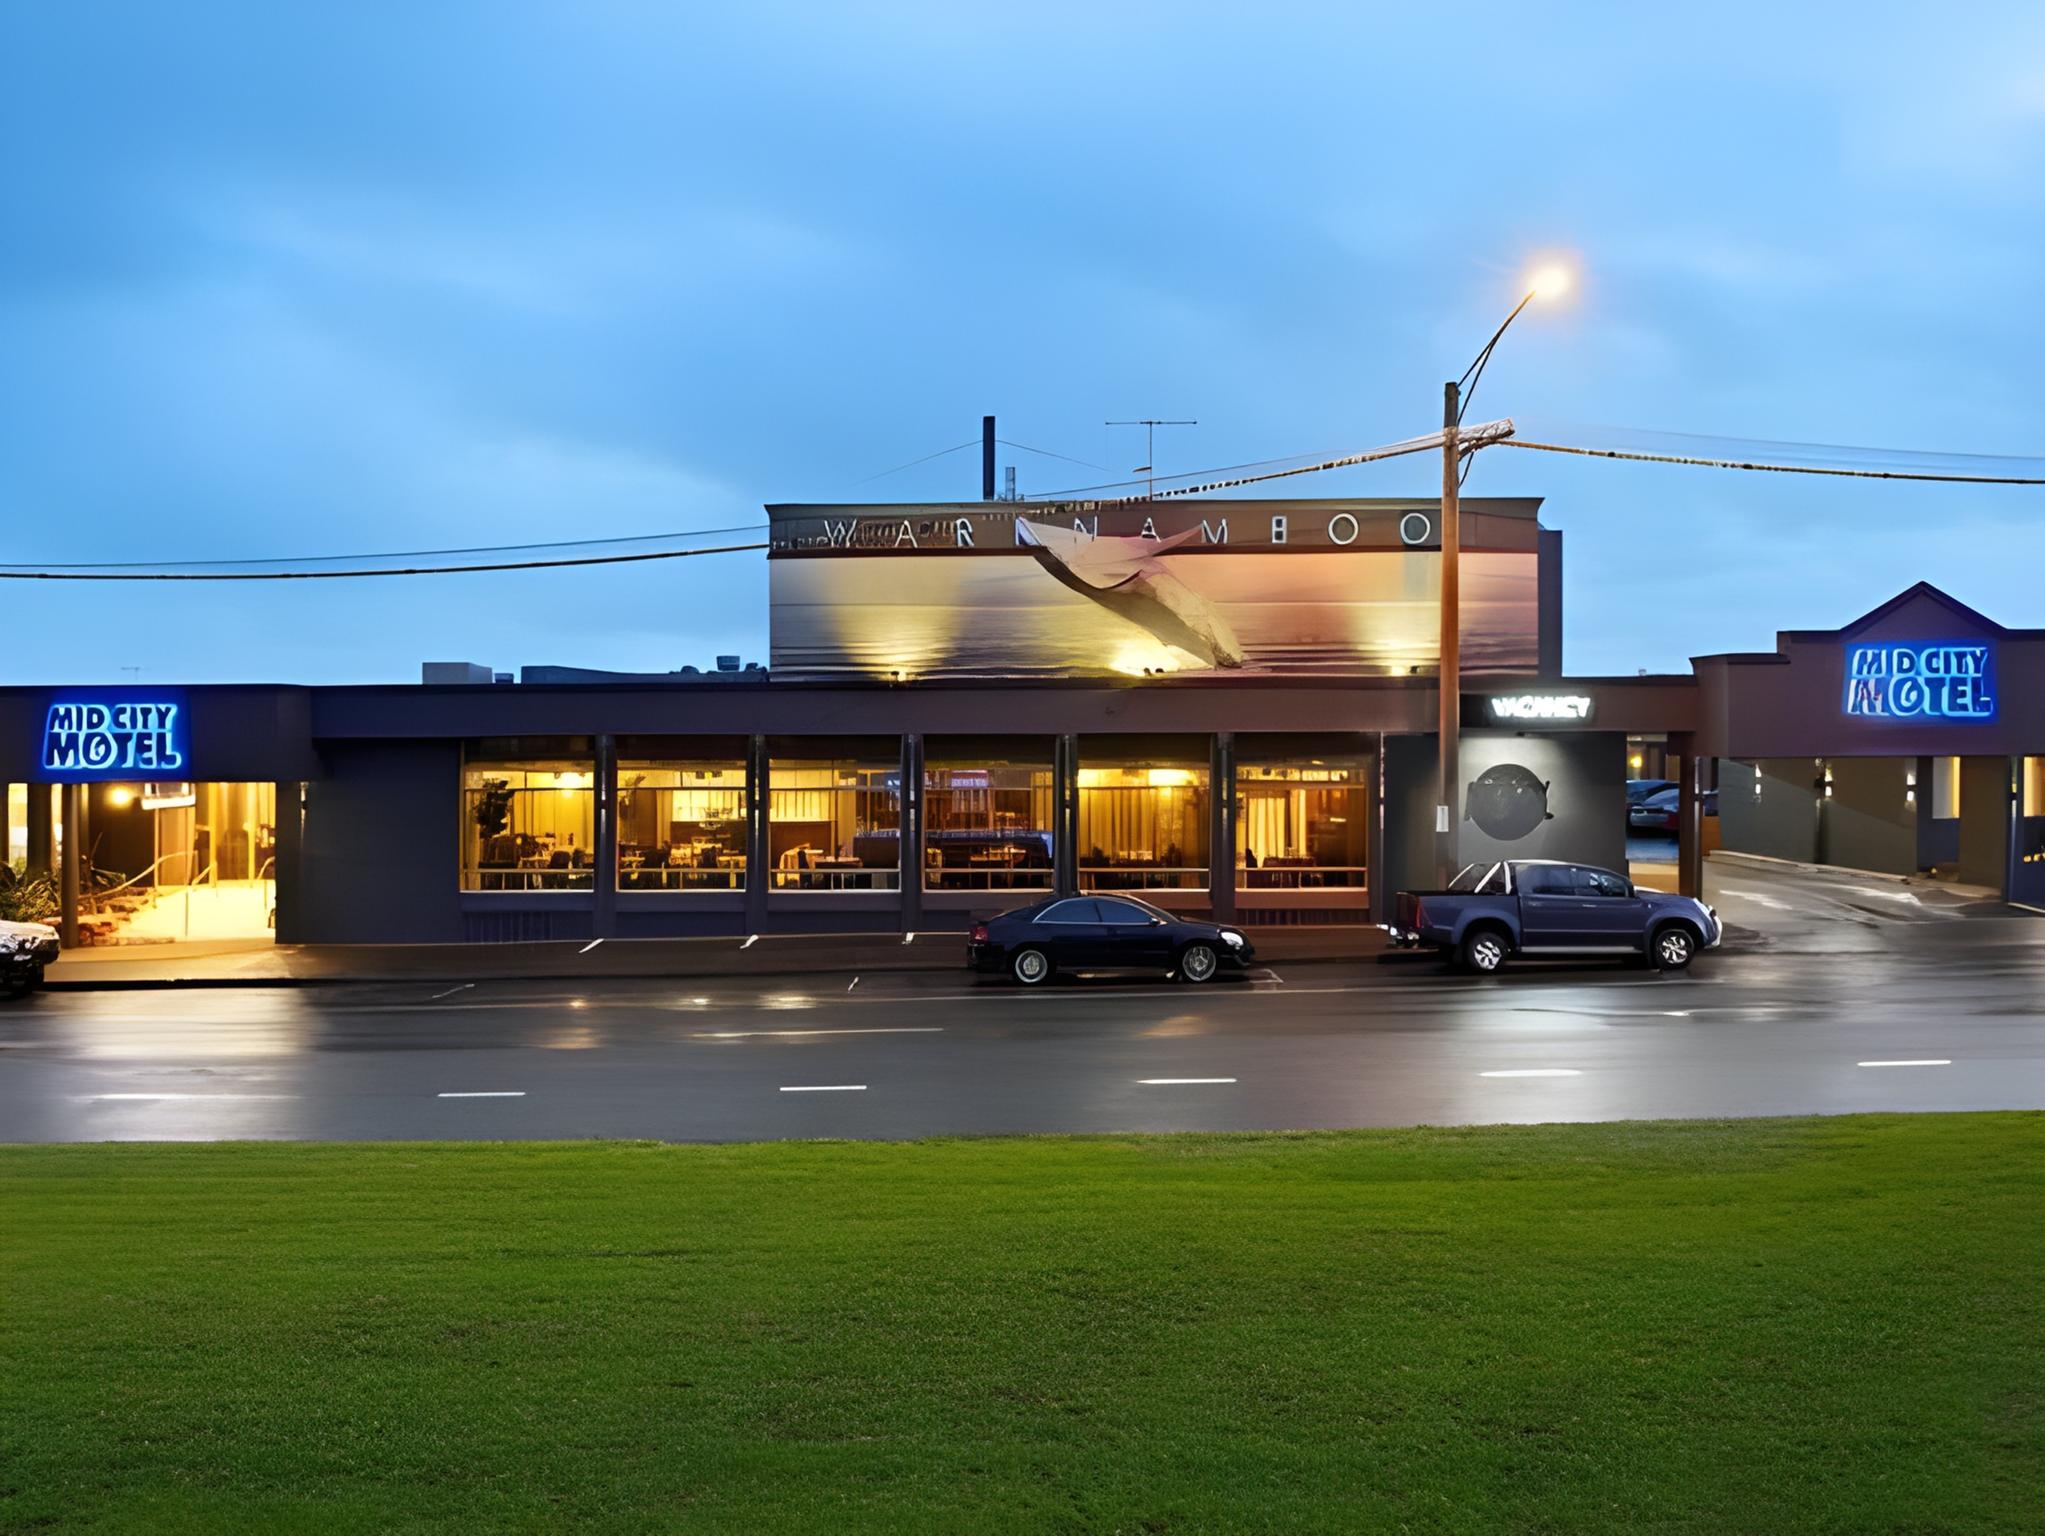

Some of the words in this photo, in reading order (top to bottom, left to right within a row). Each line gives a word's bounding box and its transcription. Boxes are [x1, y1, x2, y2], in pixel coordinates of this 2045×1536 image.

[1852, 648, 1918, 677] MID
[1920, 647, 1988, 677] CITY
[1847, 676, 1994, 717] MOTEL
[49, 704, 111, 731] MID
[111, 704, 178, 731] CITY
[44, 731, 182, 769] MOTEL
